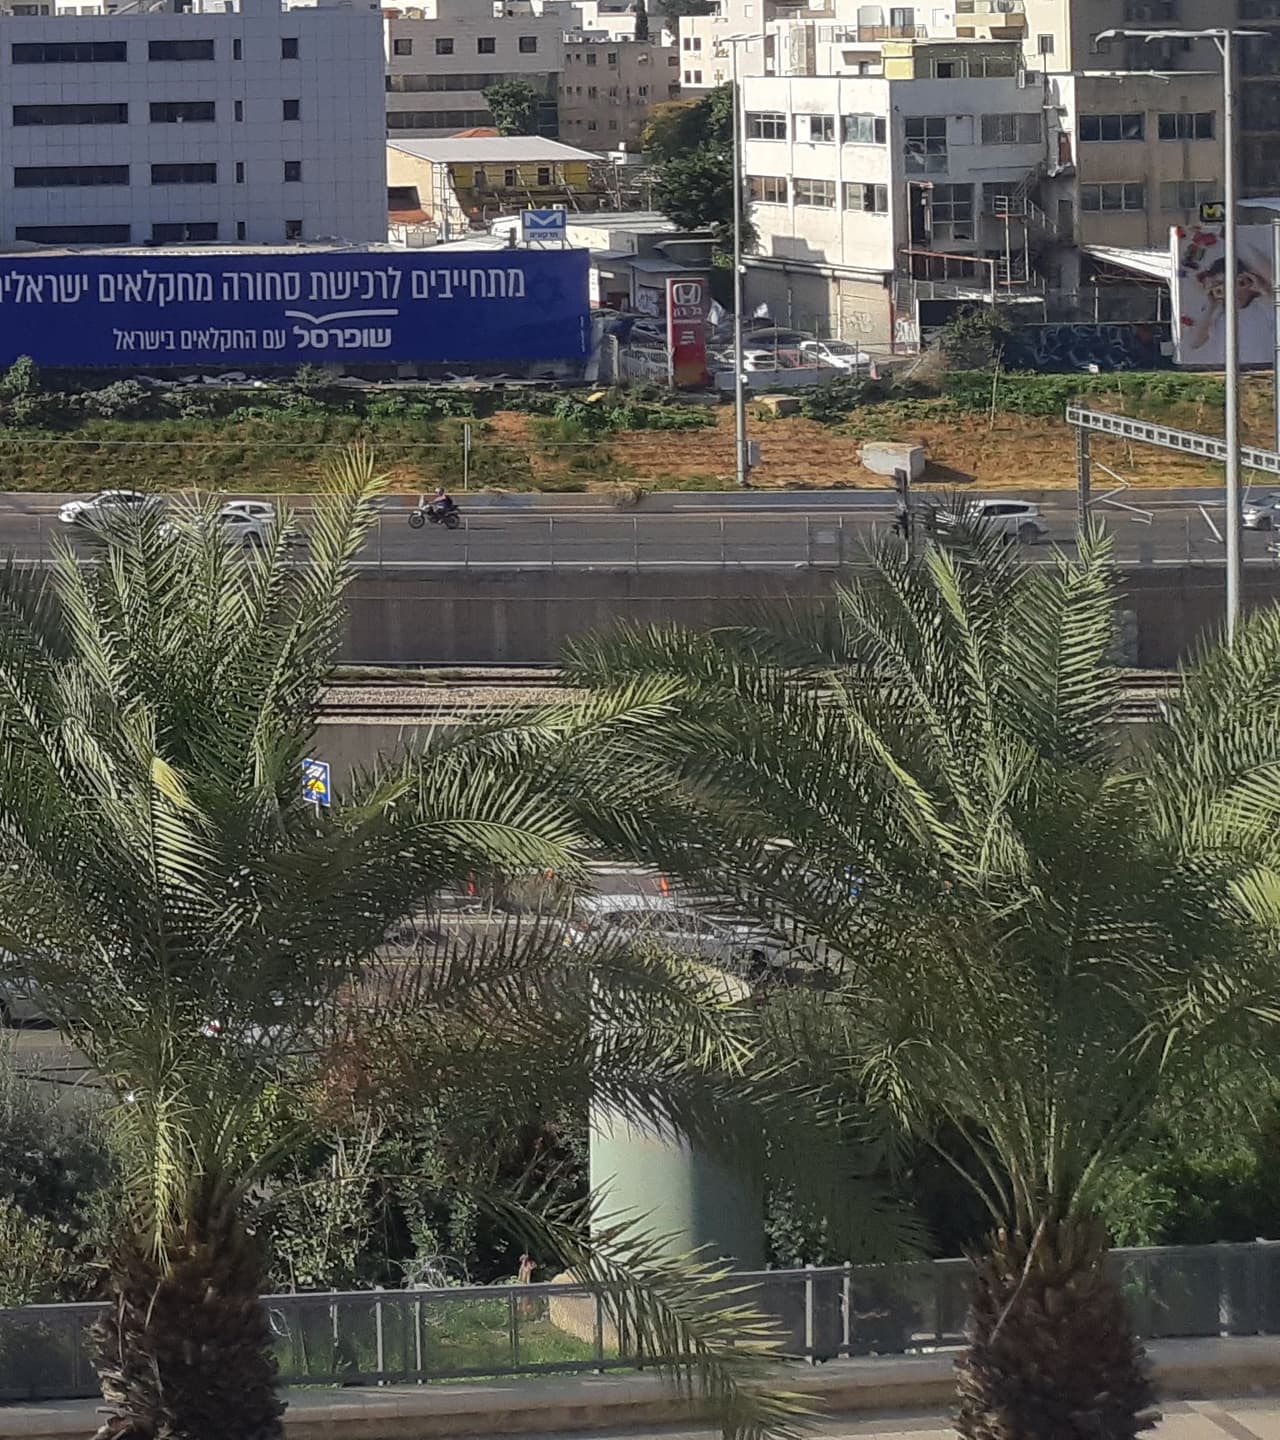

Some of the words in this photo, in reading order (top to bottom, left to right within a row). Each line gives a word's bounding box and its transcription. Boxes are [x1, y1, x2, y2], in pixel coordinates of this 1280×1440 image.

[99, 269, 213, 307] מחקלאים
[222, 271, 301, 301] סחורה
[308, 267, 403, 301] לרכישת
[411, 268, 526, 299] מתחייבים
[113, 328, 175, 350] בישראל
[181, 327, 256, 352] החקלאים
[262, 329, 285, 349] עם
[293, 326, 391, 349] שופרסל
